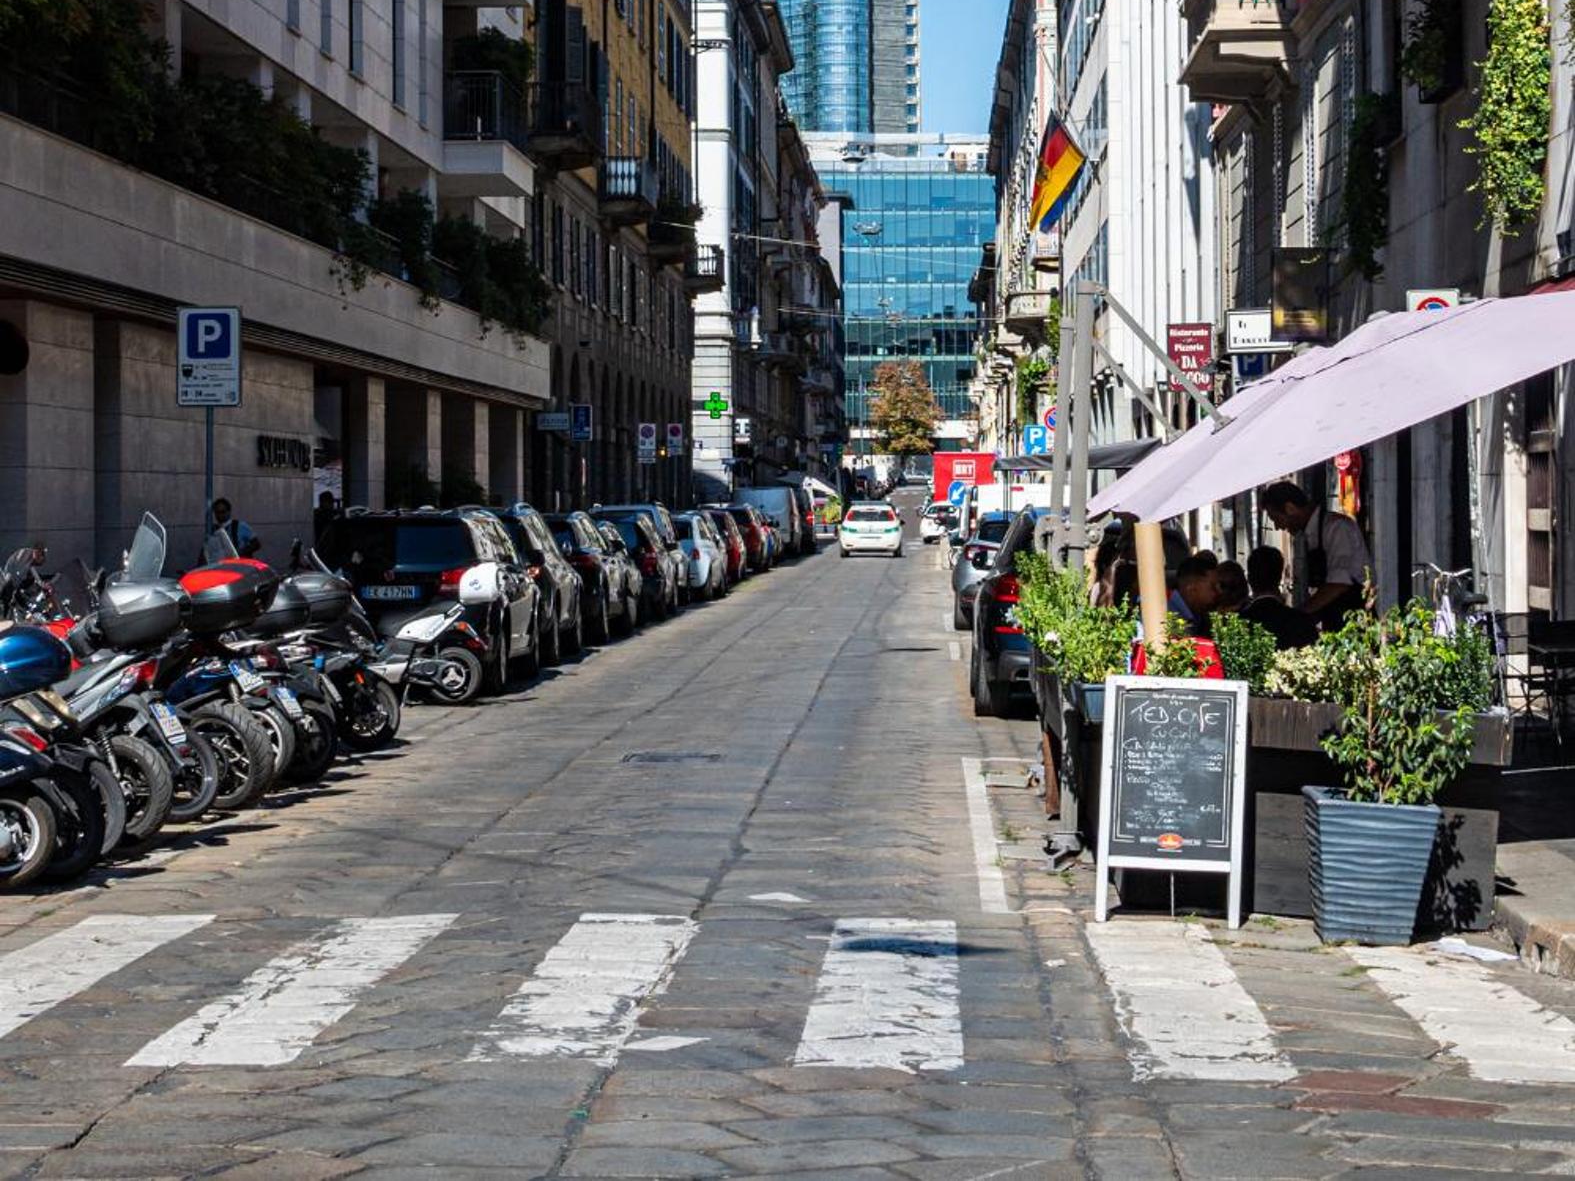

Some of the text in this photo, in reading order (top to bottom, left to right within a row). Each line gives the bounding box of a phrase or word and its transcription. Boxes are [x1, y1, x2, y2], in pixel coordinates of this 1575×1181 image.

[197, 319, 222, 353] P
[1169, 328, 1209, 337] Ristorante
[1174, 343, 1204, 352] Pizzeria
[1181, 355, 1198, 369] DA
[1029, 428, 1043, 444] P
